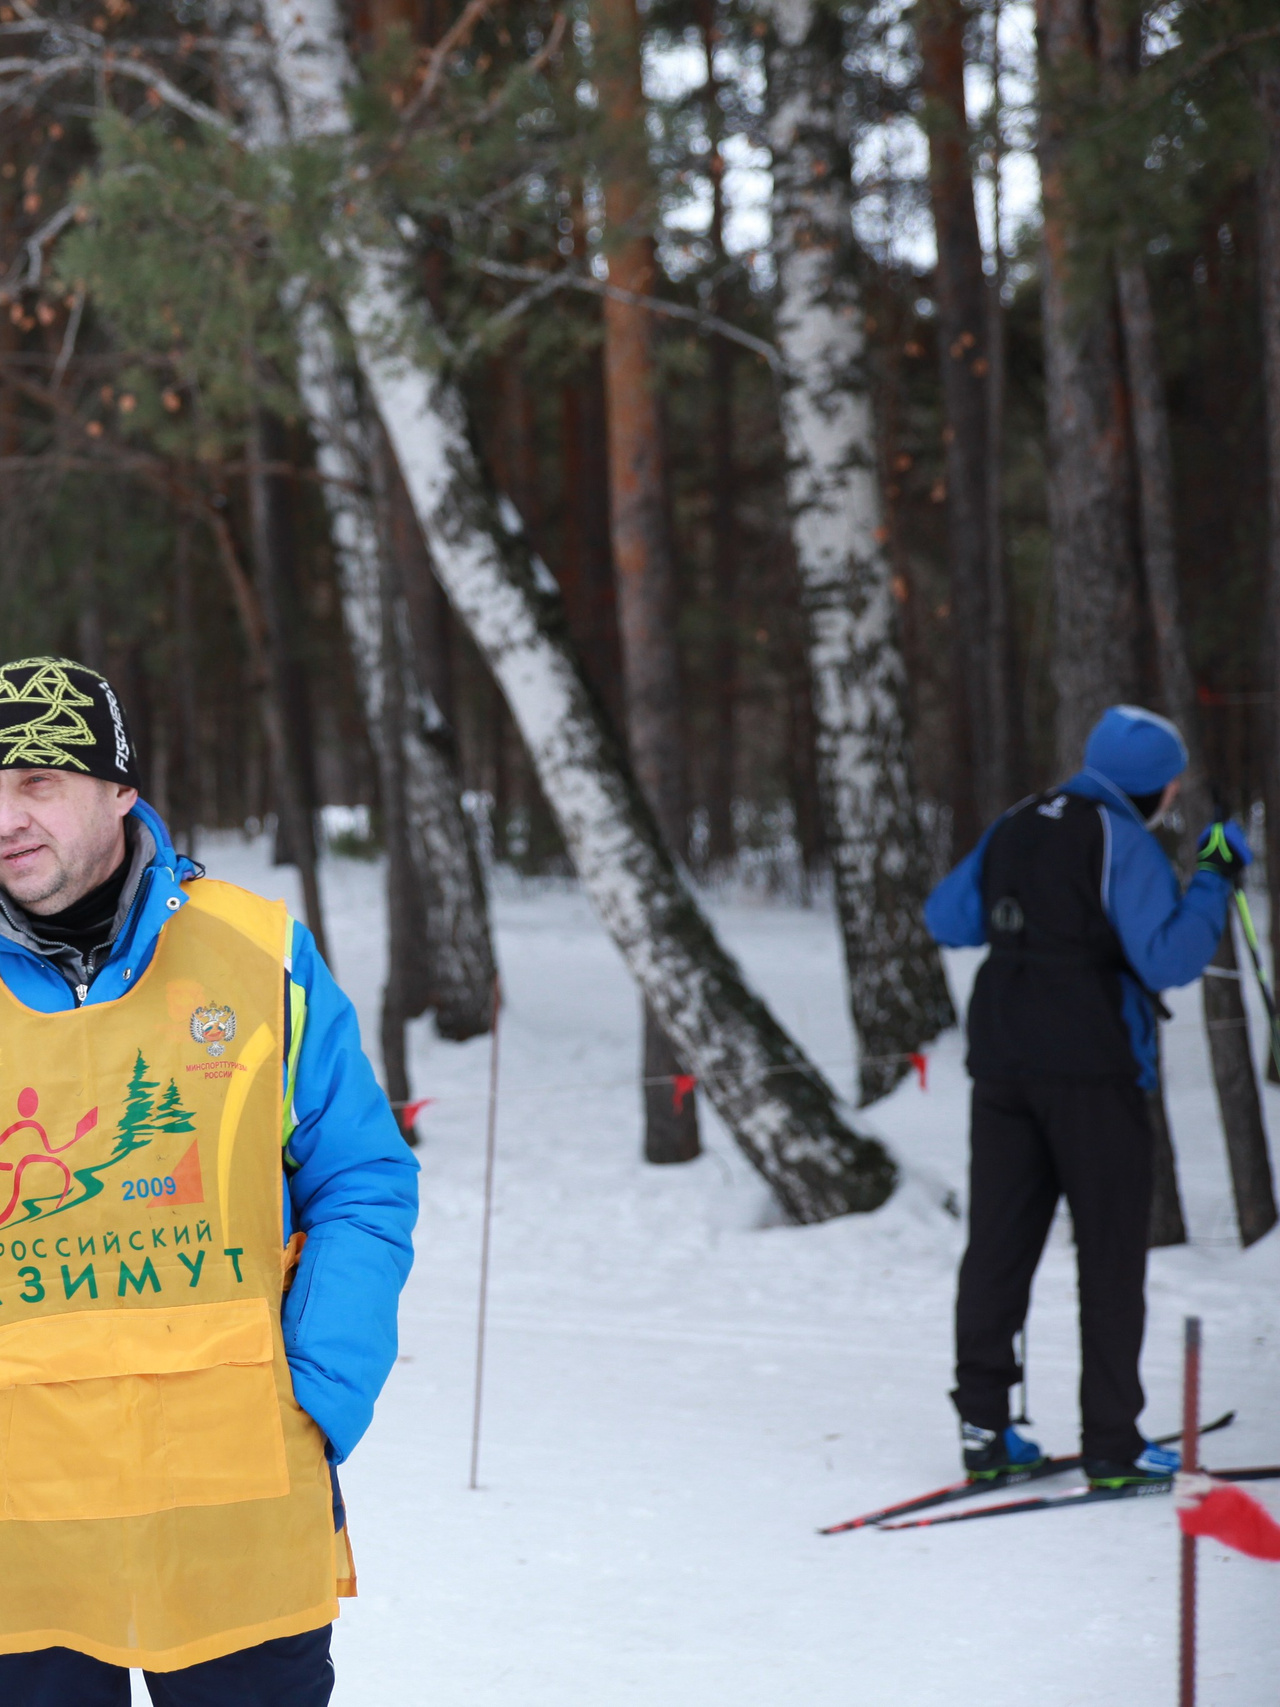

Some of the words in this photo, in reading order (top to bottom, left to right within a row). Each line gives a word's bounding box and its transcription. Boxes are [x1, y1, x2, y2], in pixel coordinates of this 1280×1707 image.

[105, 689, 130, 773] FISCHER
[204, 1070, 233, 1079] РОССИИ
[121, 1175, 177, 1201] 2009
